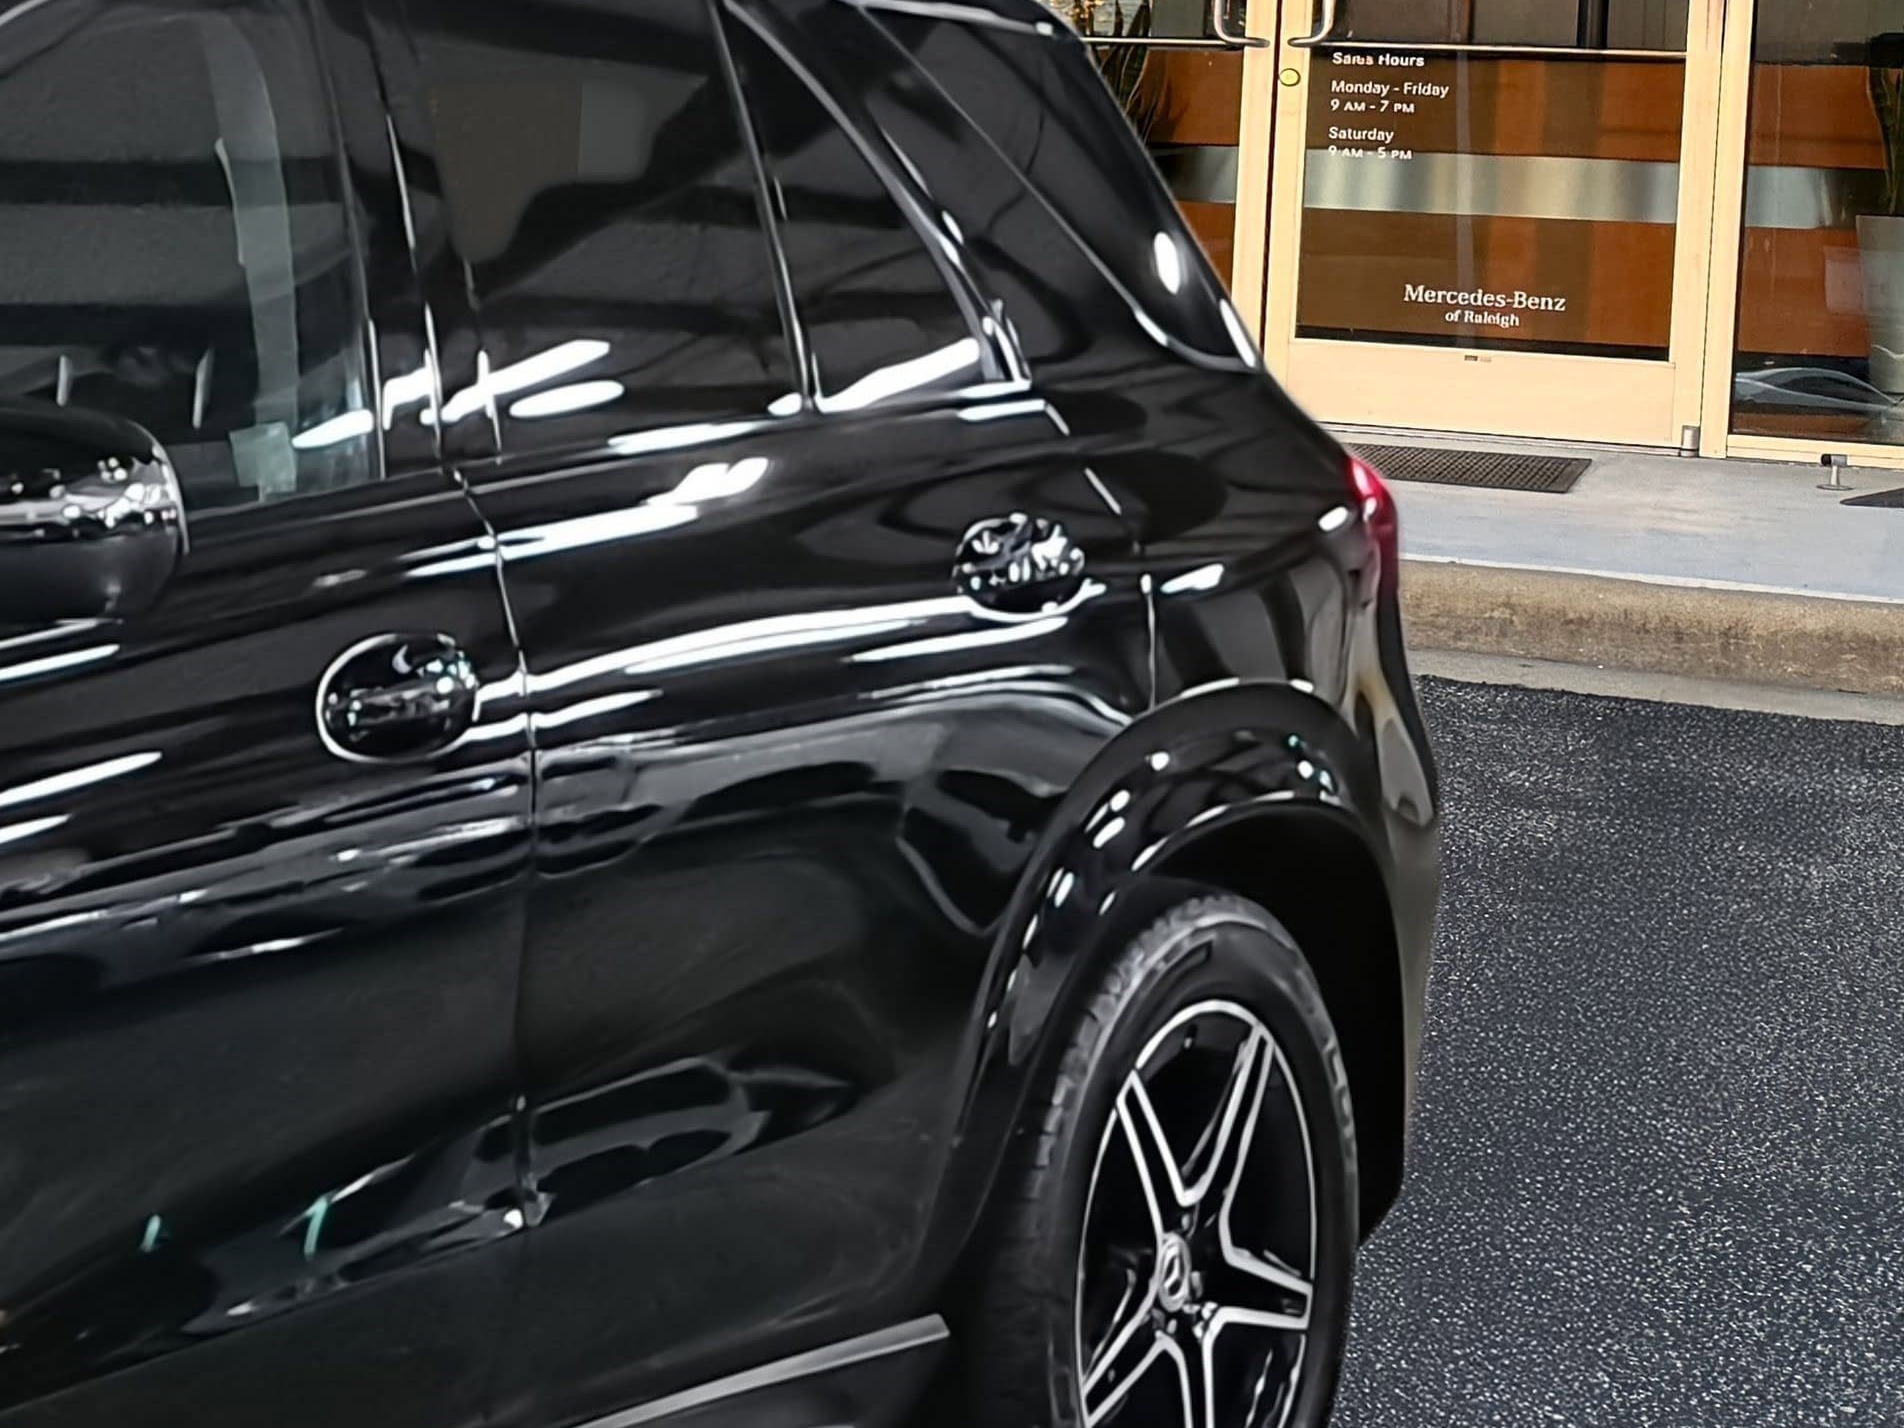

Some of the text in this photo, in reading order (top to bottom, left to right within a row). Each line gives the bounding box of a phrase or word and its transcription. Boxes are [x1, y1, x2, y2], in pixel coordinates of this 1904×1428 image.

[1378, 54, 1425, 67] Hours
[1331, 80, 1390, 97] Monday
[1403, 82, 1449, 98] Friday
[1330, 99, 1340, 111] 9
[1343, 101, 1366, 111] AM
[1379, 100, 1389, 112] 7
[1393, 103, 1415, 113] PM
[1328, 126, 1394, 143] Saturday
[1327, 145, 1336, 157] 9
[1342, 148, 1364, 158] AM
[1378, 147, 1387, 158] 5
[1392, 150, 1413, 160] PM
[1403, 284, 1566, 311] Mercedes-Benz
[1445, 310, 1459, 322] of
